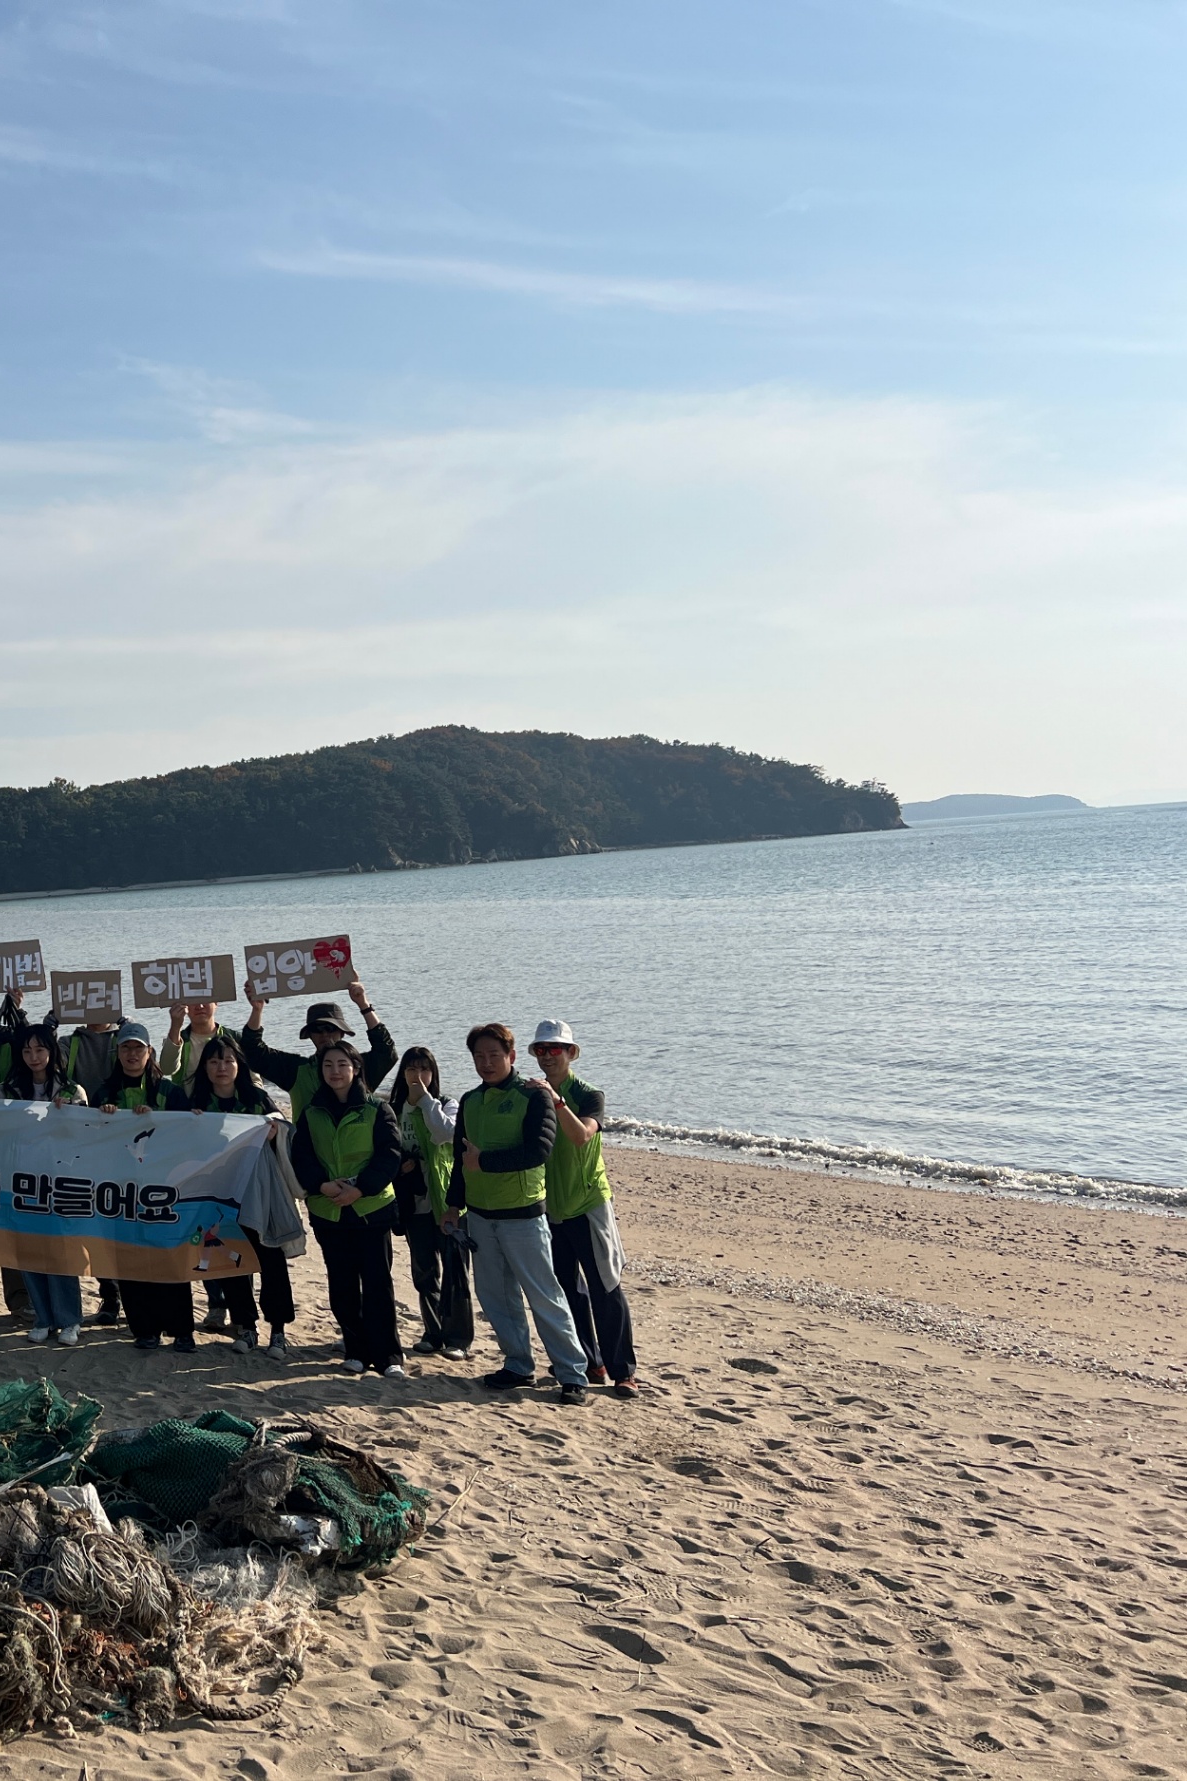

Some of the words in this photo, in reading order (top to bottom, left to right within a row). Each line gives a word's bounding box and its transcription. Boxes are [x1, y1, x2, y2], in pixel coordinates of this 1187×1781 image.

[141, 960, 212, 999] 해변
[247, 949, 316, 996] 입양
[58, 981, 120, 1018] 반려
[12, 1172, 180, 1225] 만들어요
